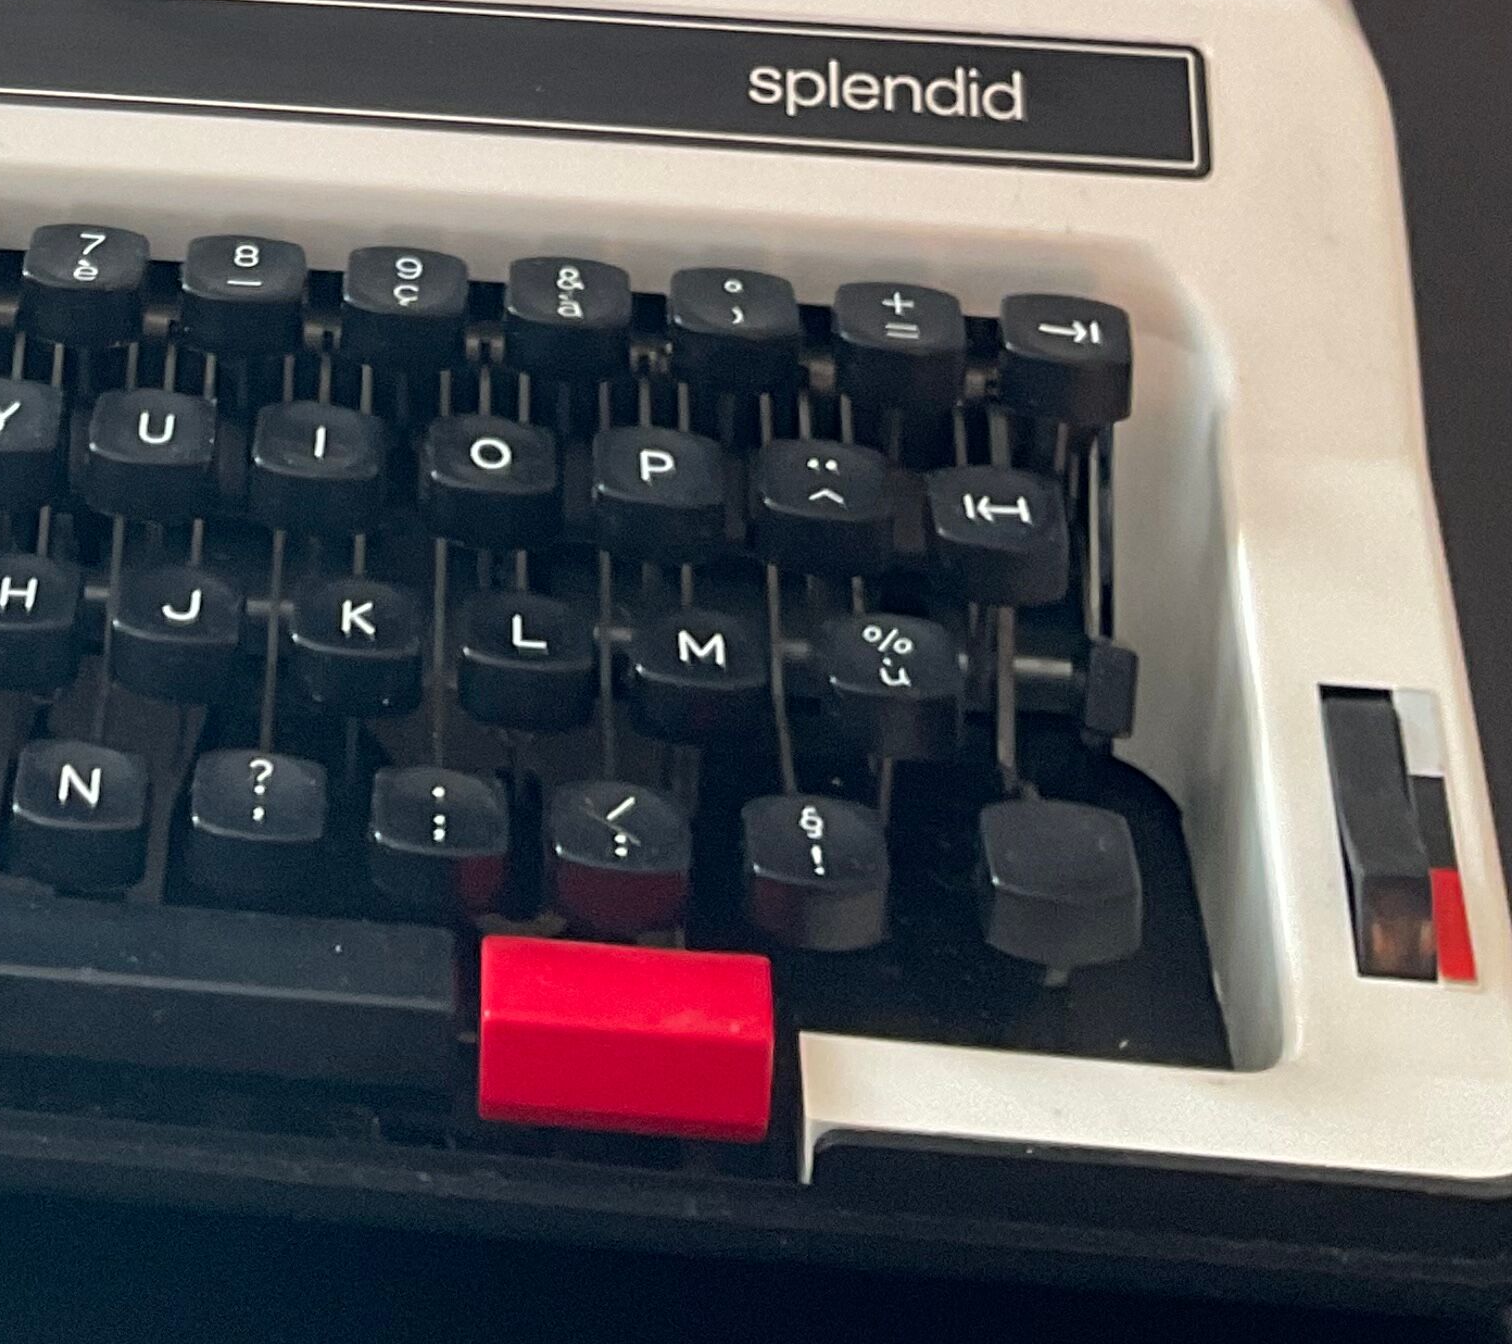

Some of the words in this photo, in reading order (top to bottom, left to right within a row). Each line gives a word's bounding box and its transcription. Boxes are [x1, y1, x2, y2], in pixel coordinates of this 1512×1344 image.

[748, 58, 1028, 123] splendid
[80, 232, 106, 256] 7
[234, 244, 259, 267] 8
[395, 257, 423, 280] 9
[556, 267, 584, 291] &
[393, 284, 419, 306] ç
[138, 411, 175, 445] U
[470, 437, 512, 470] O
[639, 449, 675, 482] P
[162, 589, 202, 622] J
[341, 599, 376, 636] K
[512, 614, 547, 650] L
[678, 630, 726, 666] M
[862, 625, 913, 655] %
[58, 764, 101, 807] N
[249, 758, 274, 795] ?
[809, 843, 826, 876] !
